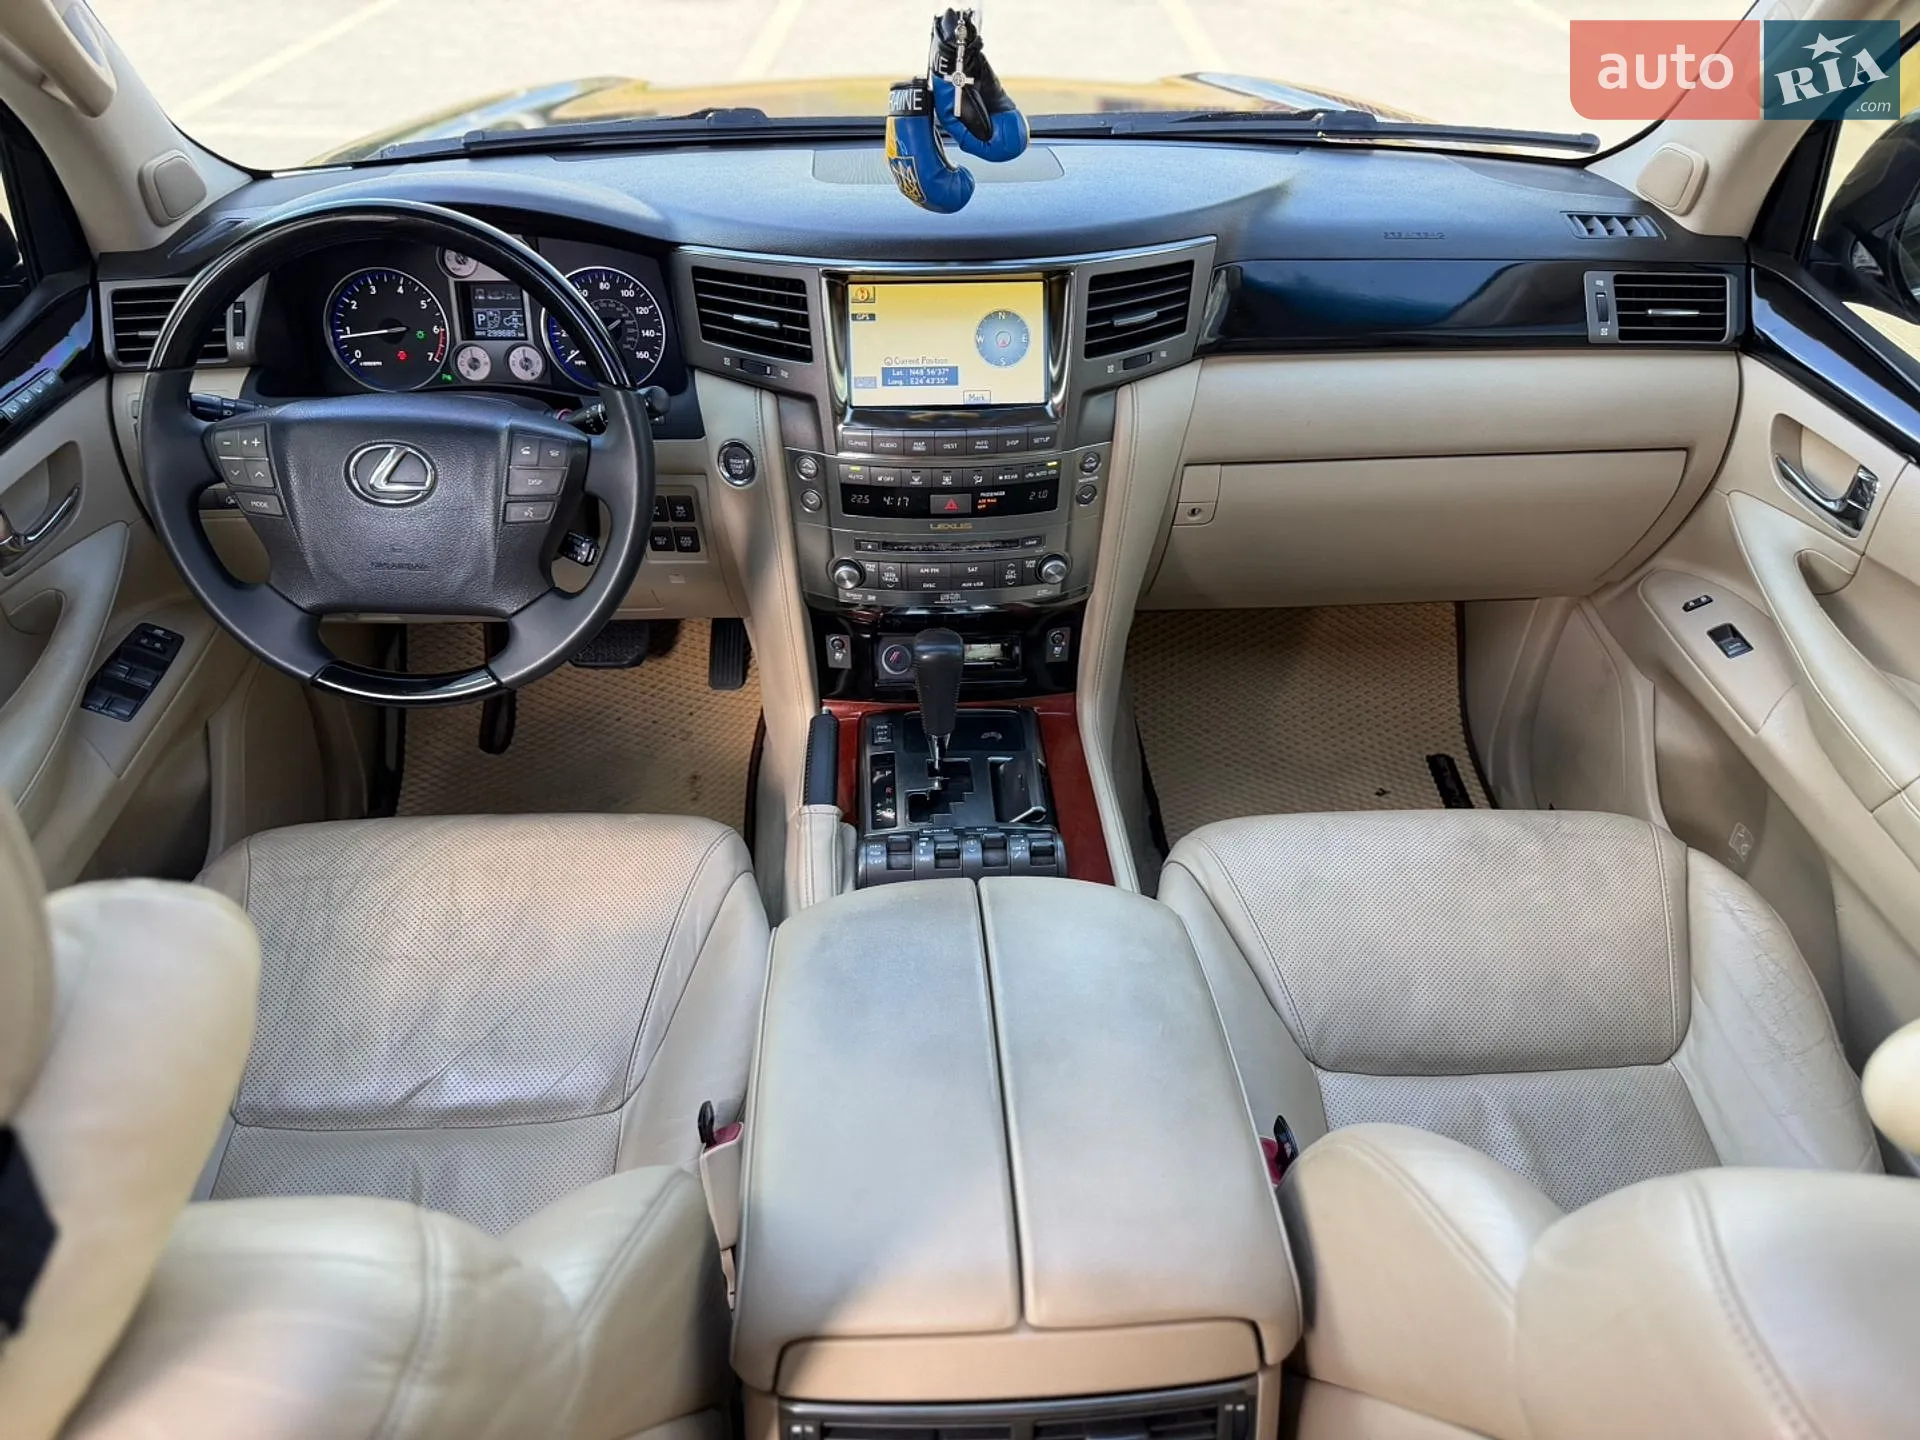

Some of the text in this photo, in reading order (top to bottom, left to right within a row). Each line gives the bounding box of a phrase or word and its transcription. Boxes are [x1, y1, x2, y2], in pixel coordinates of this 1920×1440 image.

[370, 285, 377, 295] 3
[397, 285, 404, 295] 4
[599, 282, 610, 290] 80
[621, 289, 635, 298] 100
[350, 300, 358, 310] 2
[420, 300, 428, 309] 5
[635, 306, 650, 315] 120
[998, 311, 1006, 319] N
[477, 314, 486, 326] P
[433, 325, 440, 334] 6
[642, 329, 655, 337] 140
[976, 334, 985, 342] W
[354, 349, 362, 359] 0
[427, 352, 434, 361] 7
[636, 350, 650, 359] 160
[894, 356, 919, 365] Current
[1000, 358, 1006, 366] S
[883, 496, 909, 507] 4:17
